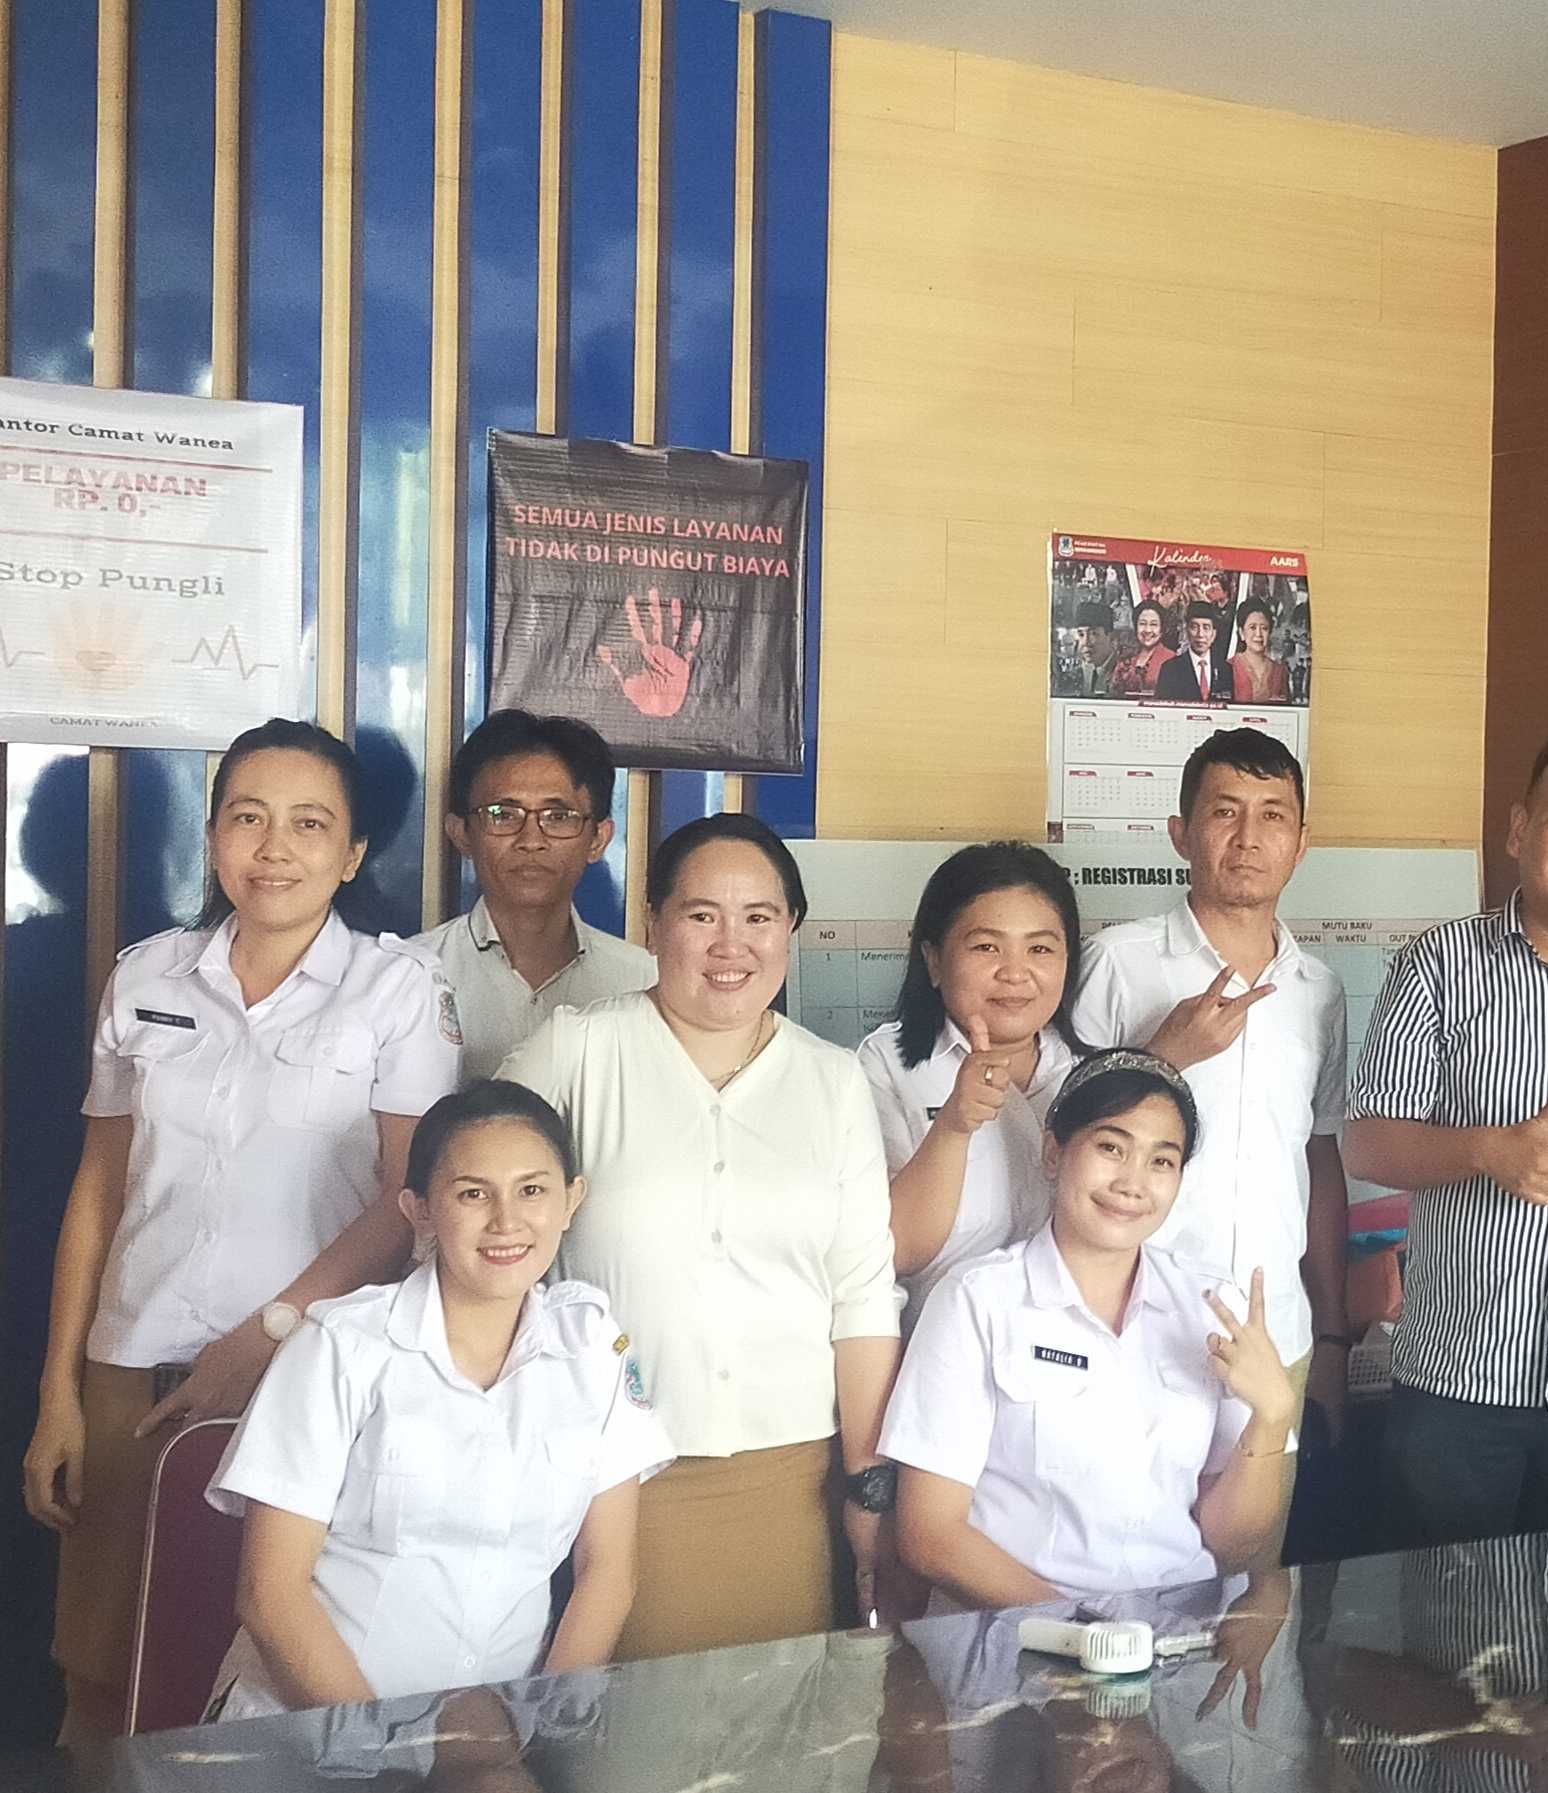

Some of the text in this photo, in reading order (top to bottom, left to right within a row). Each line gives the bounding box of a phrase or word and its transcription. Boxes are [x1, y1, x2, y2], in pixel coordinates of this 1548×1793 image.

[68, 424, 145, 442] Camat
[154, 431, 235, 451] Wanea
[0, 460, 208, 497] PELAYANAN
[53, 487, 109, 512] RP.
[513, 504, 784, 545] SEMUA JENIS LAYANAN
[505, 536, 790, 578] TIDAK DI PUNGUT BIAYA
[1270, 555, 1299, 568] AARS
[0, 561, 225, 599] Stop Pungli
[49, 716, 102, 727] CAMAT
[1082, 867, 1173, 886] REGISTRASI
[819, 930, 836, 940] NO
[1322, 921, 1373, 931] MUTU BAKU
[1335, 934, 1367, 943] WAKTU
[826, 953, 831, 962] 1
